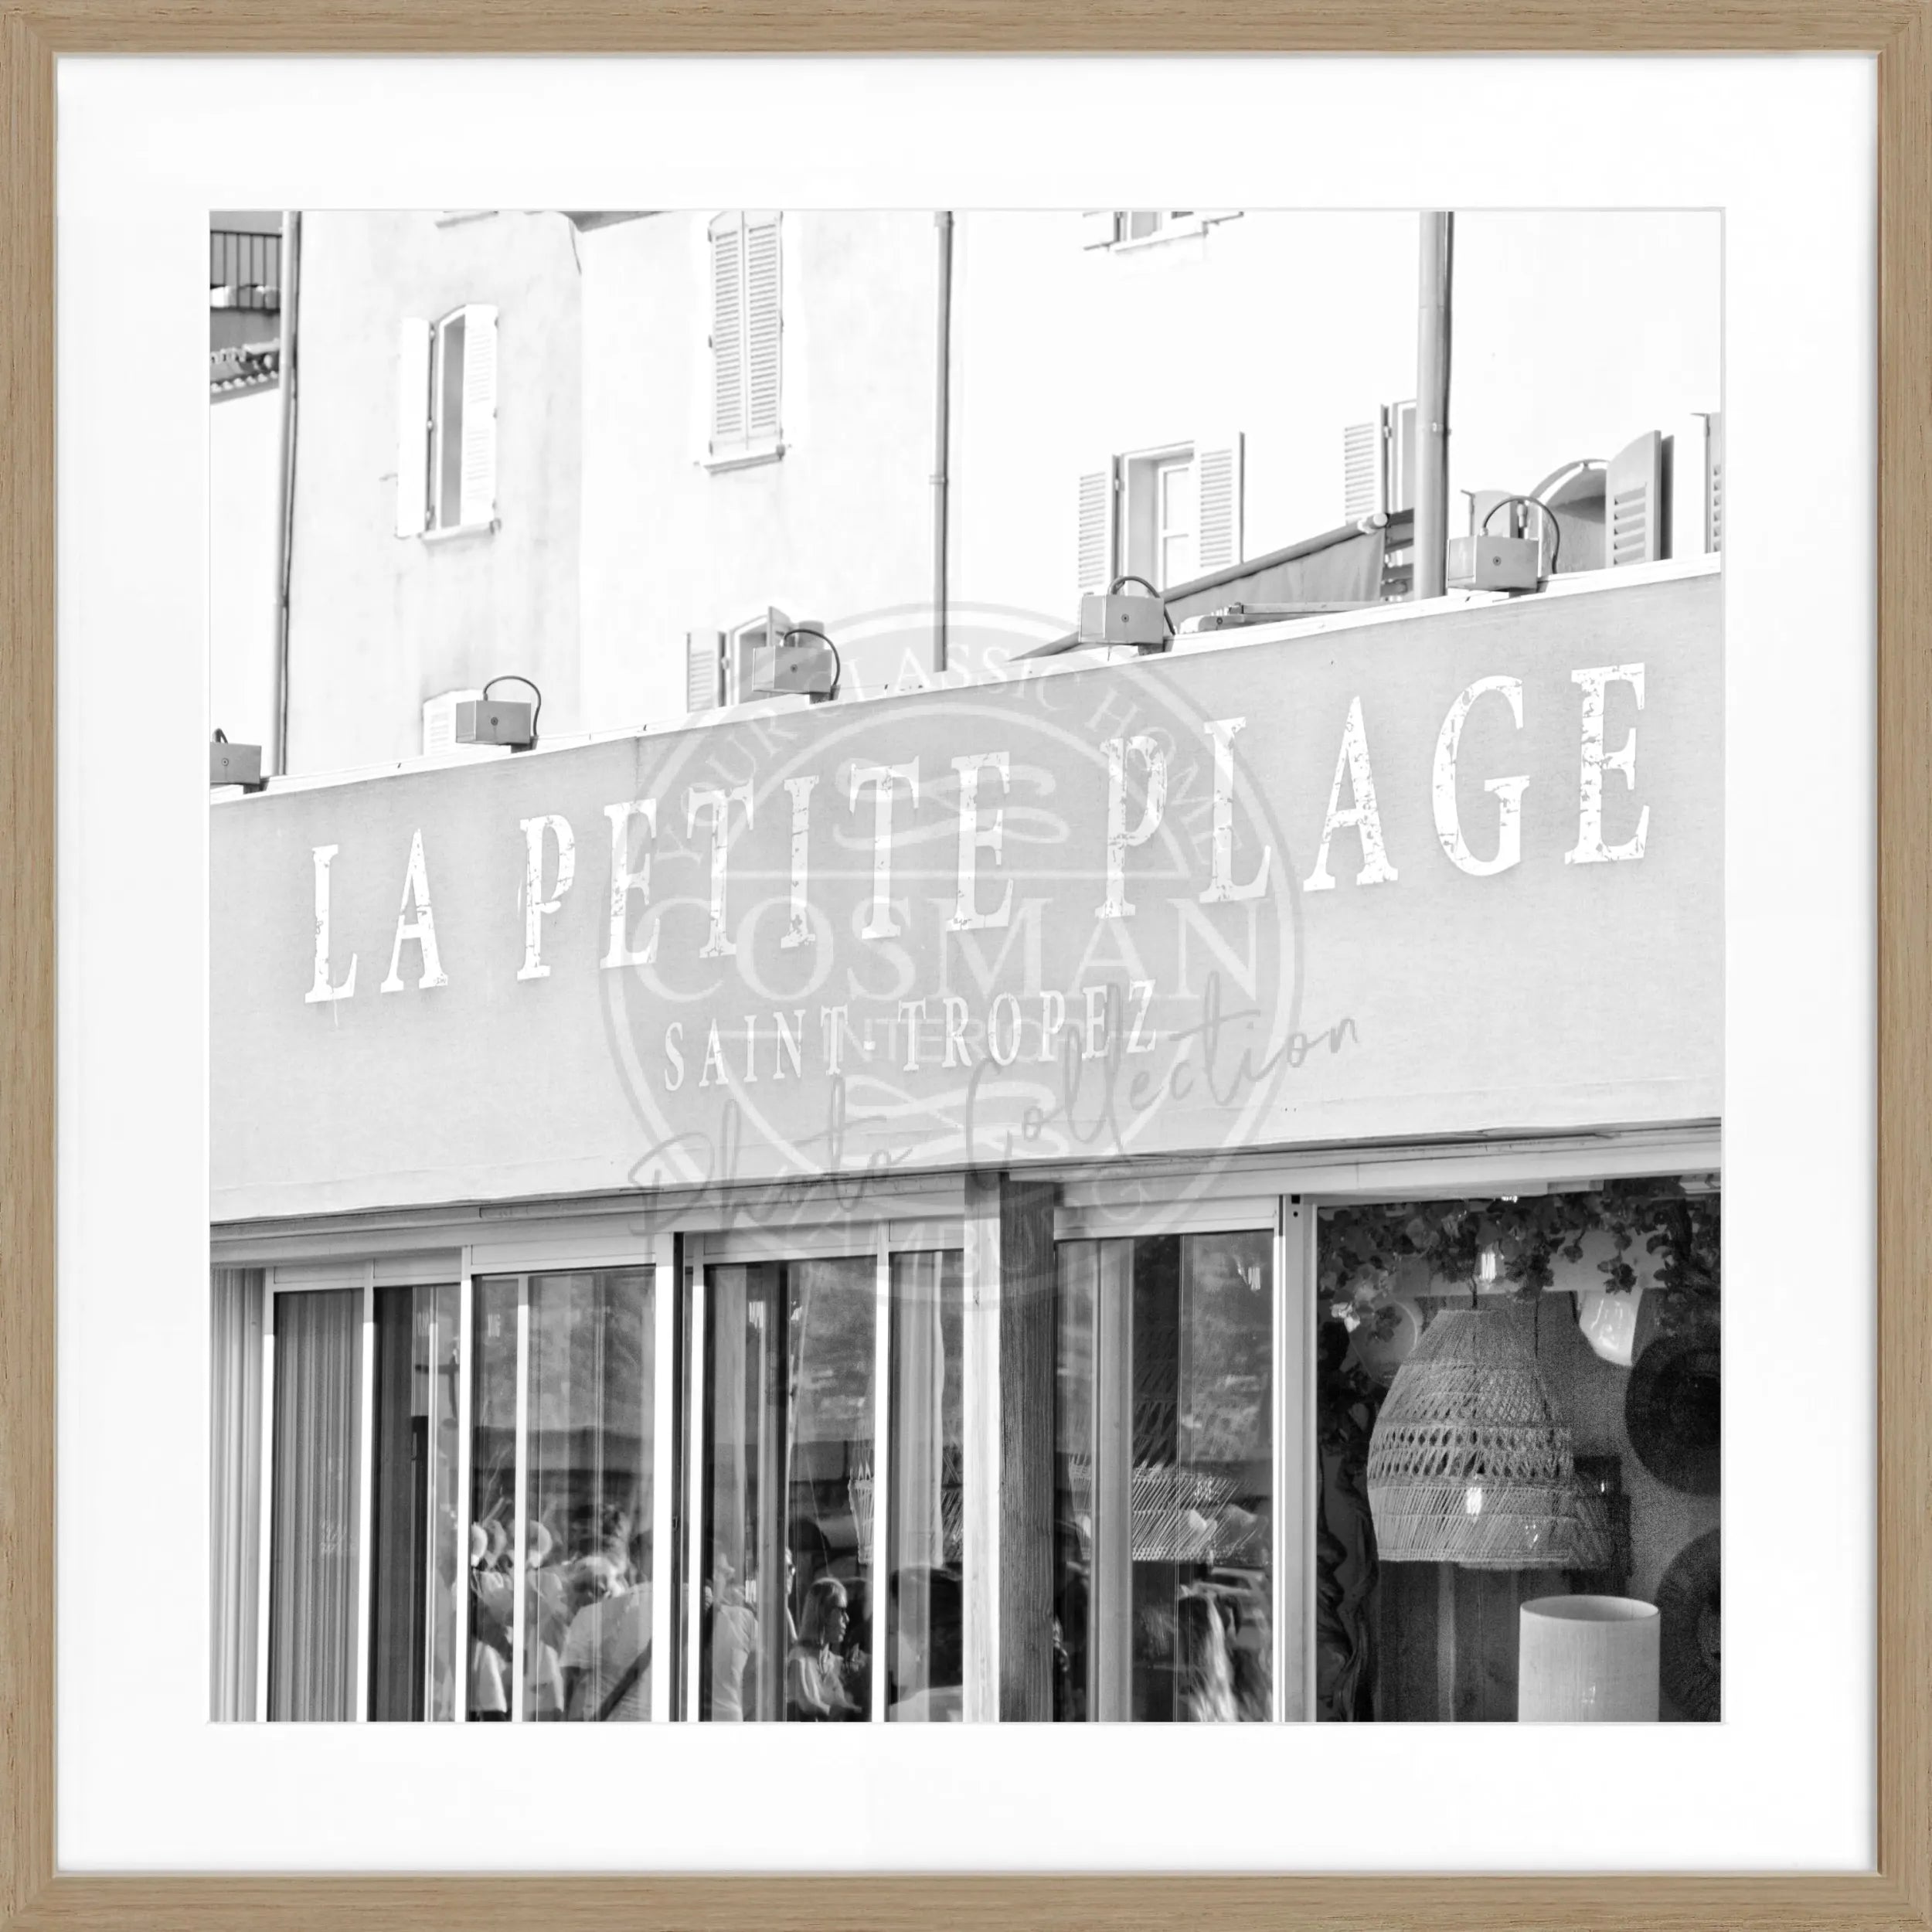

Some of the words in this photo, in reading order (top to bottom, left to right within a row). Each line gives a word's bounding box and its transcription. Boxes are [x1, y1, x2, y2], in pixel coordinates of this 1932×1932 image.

[305, 828, 448, 1003] LA
[517, 751, 1013, 981] PETITE
[1095, 662, 1649, 919] PLAGE
